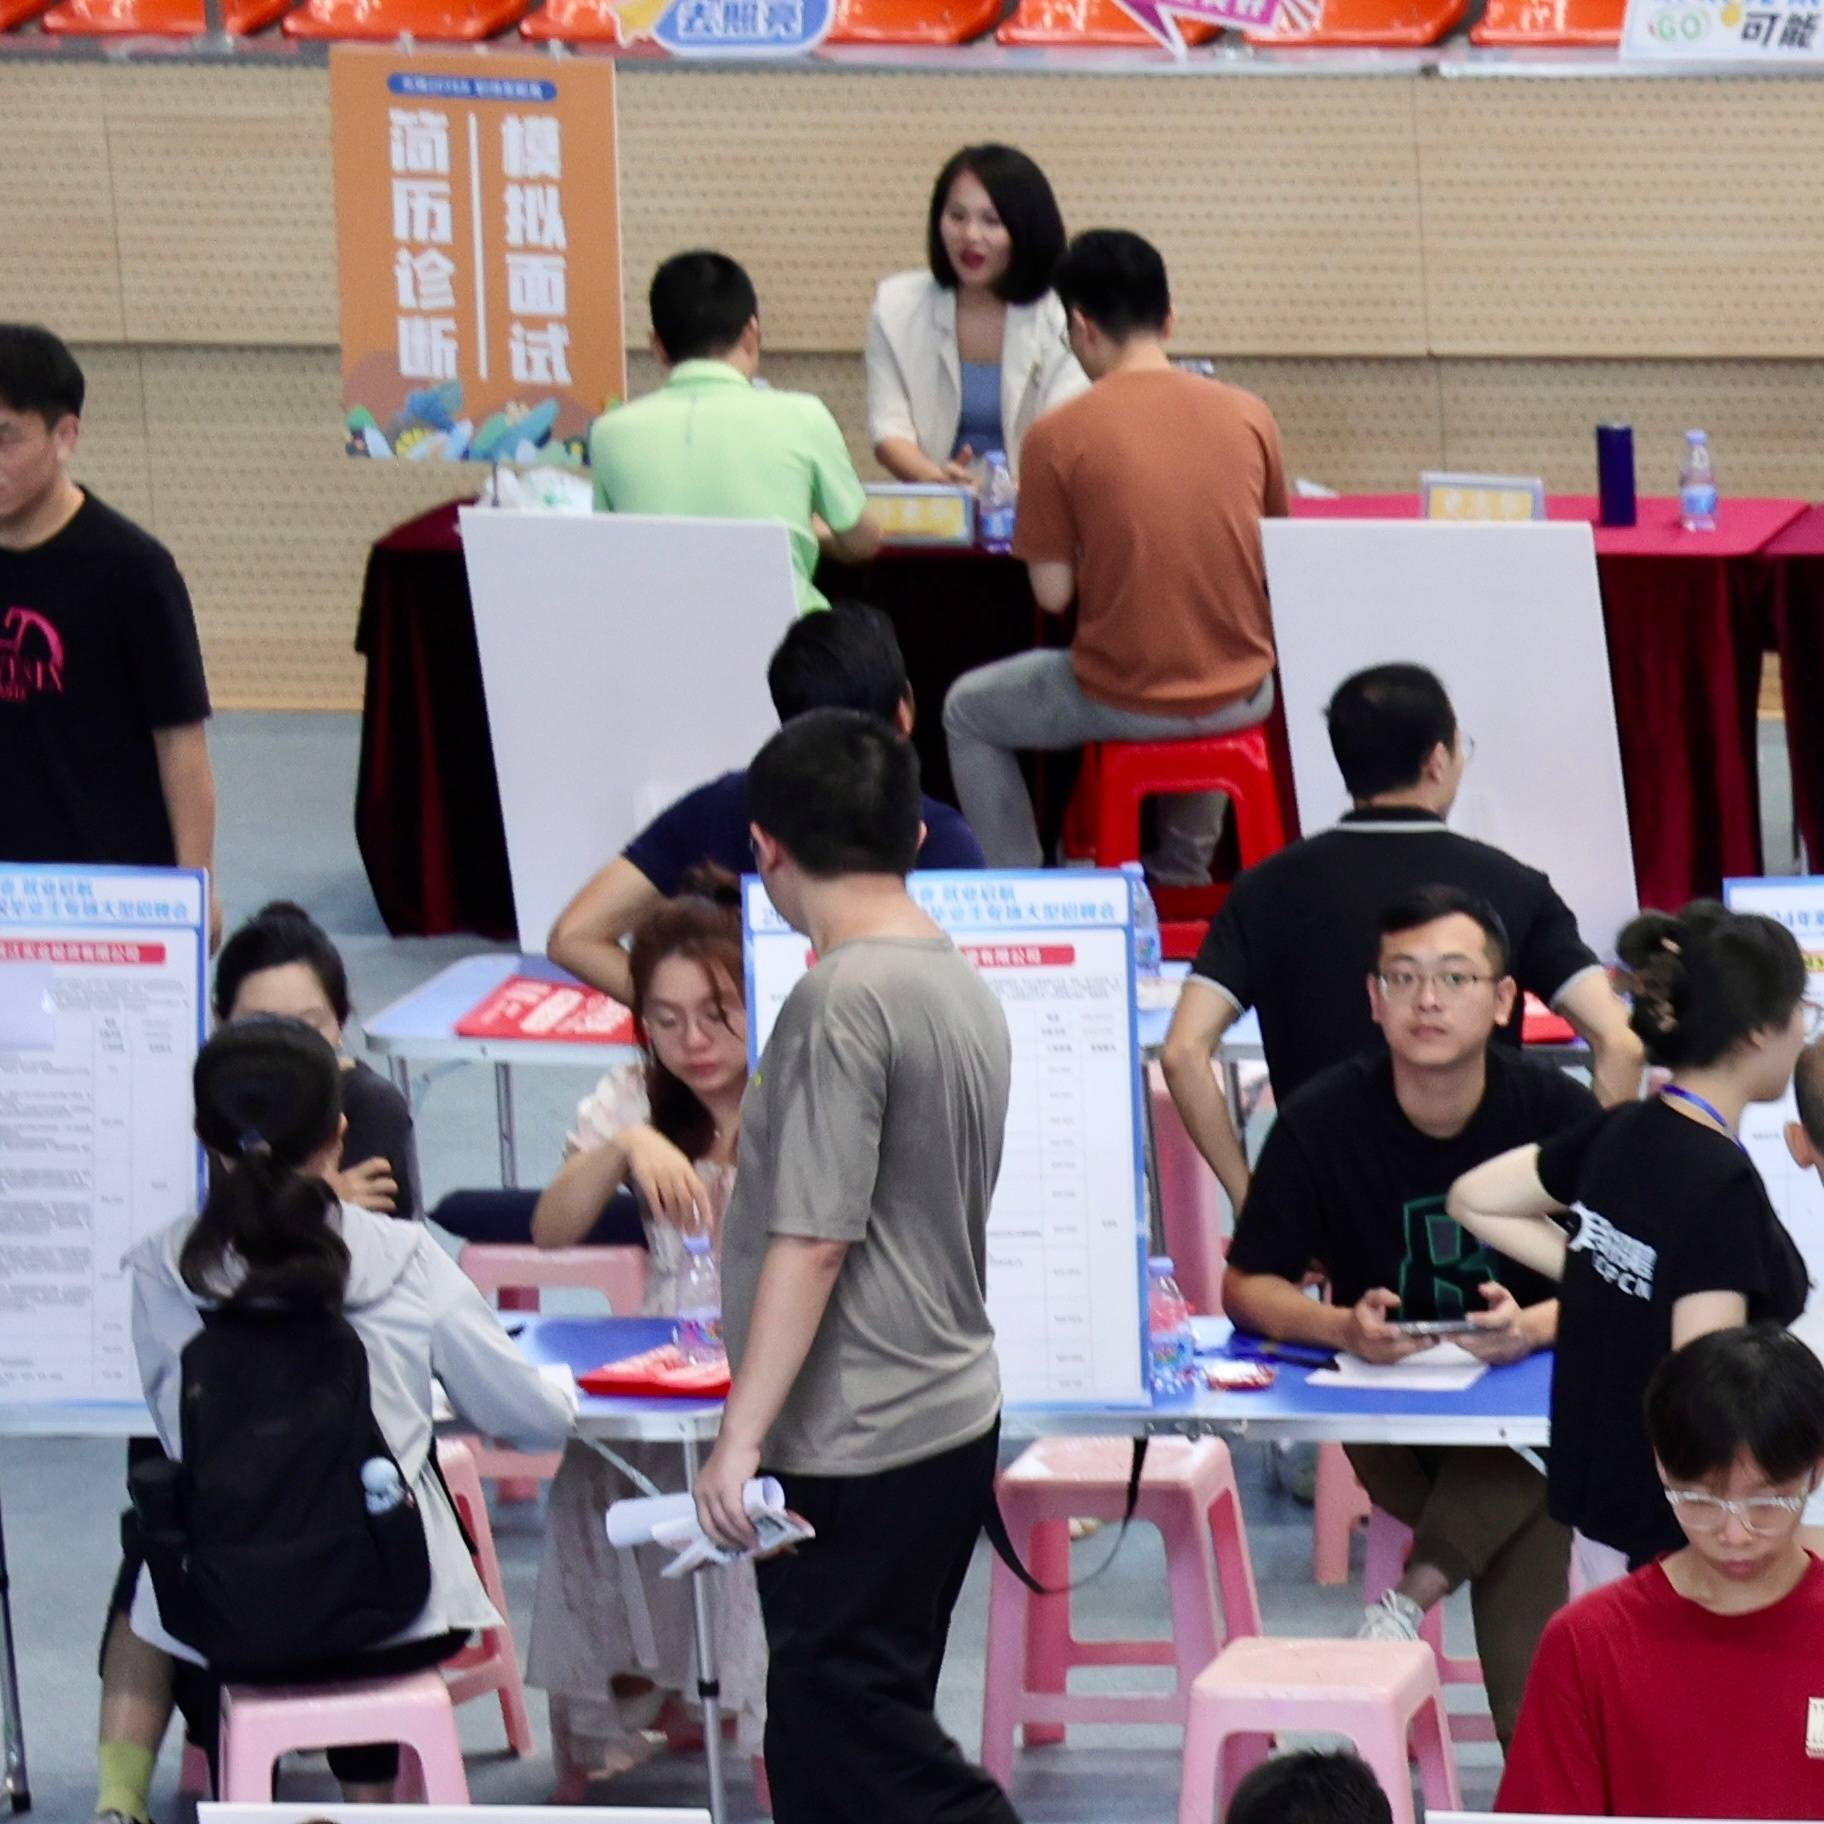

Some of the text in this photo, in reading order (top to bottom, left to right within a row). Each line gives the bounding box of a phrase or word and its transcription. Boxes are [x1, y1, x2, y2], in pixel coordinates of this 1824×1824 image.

[389, 107, 458, 380] 简历诊断
[502, 113, 572, 385] 模拟面试
